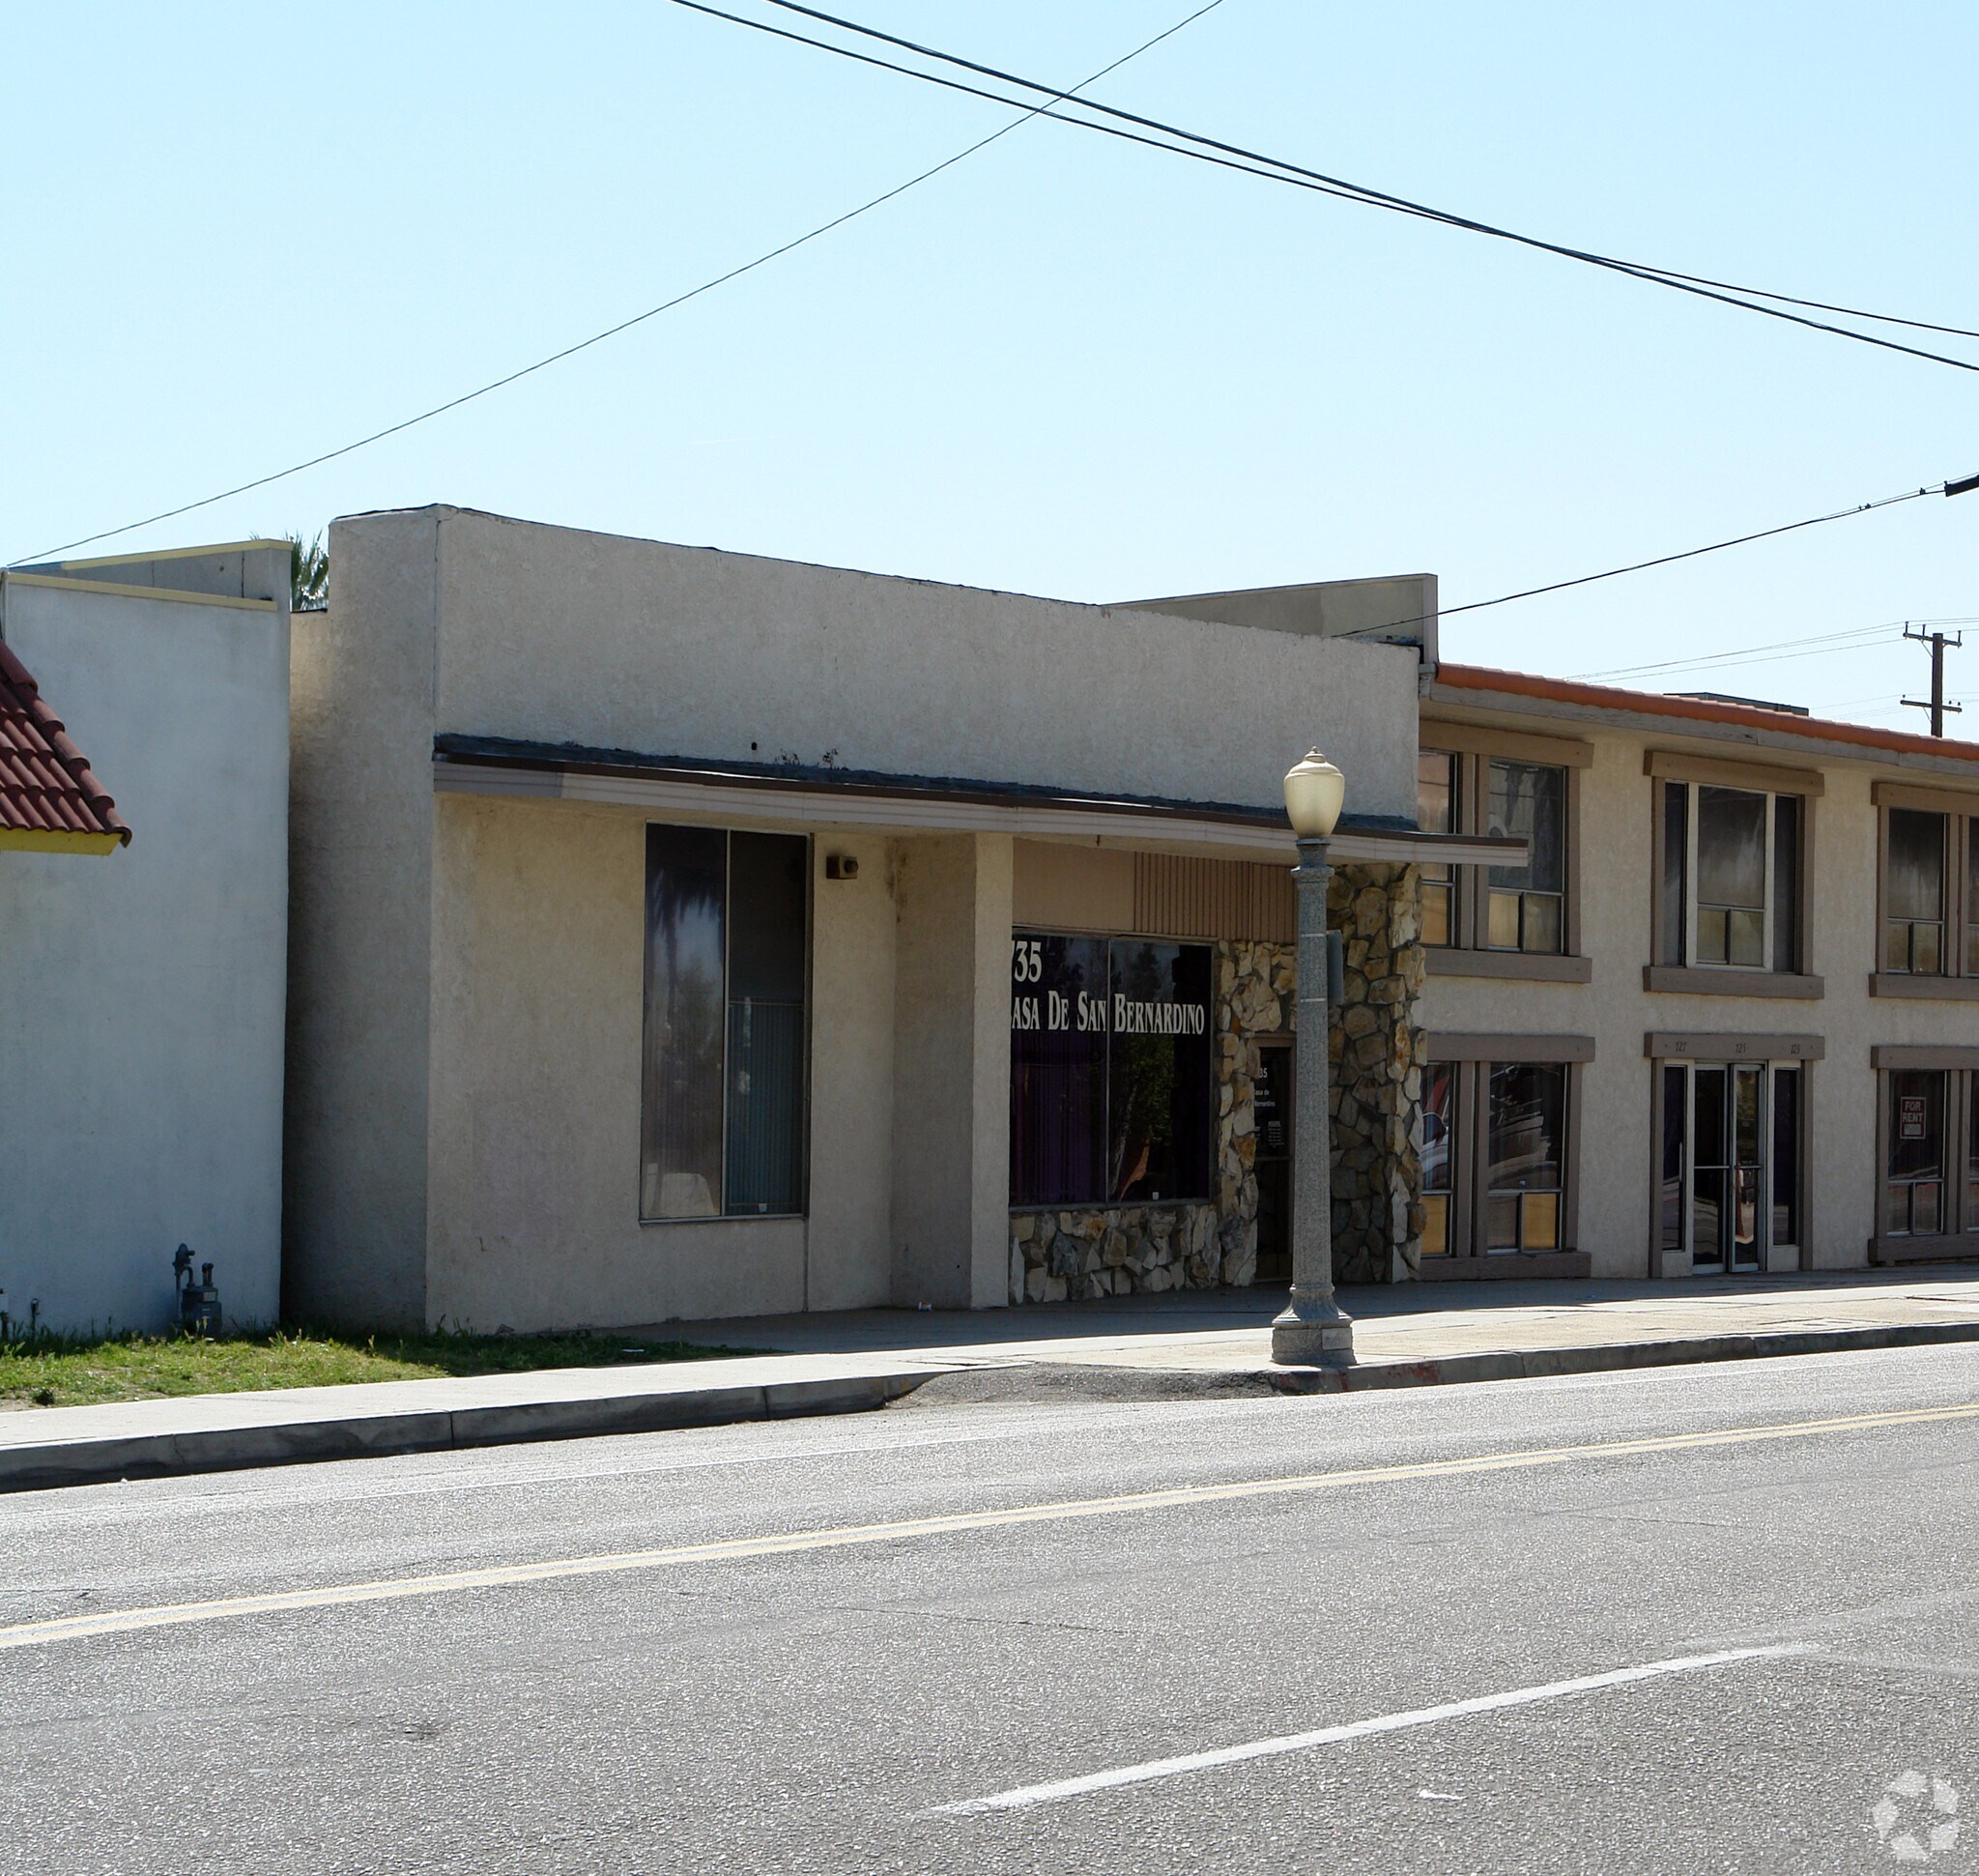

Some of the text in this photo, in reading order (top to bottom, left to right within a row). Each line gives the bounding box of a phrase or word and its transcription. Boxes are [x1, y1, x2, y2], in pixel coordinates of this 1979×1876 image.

[1012, 939, 1043, 983] 35
[1011, 996, 1041, 1030] ASA
[1903, 1112, 1923, 1122] RENT
[1905, 1101, 1921, 1111] FOR
